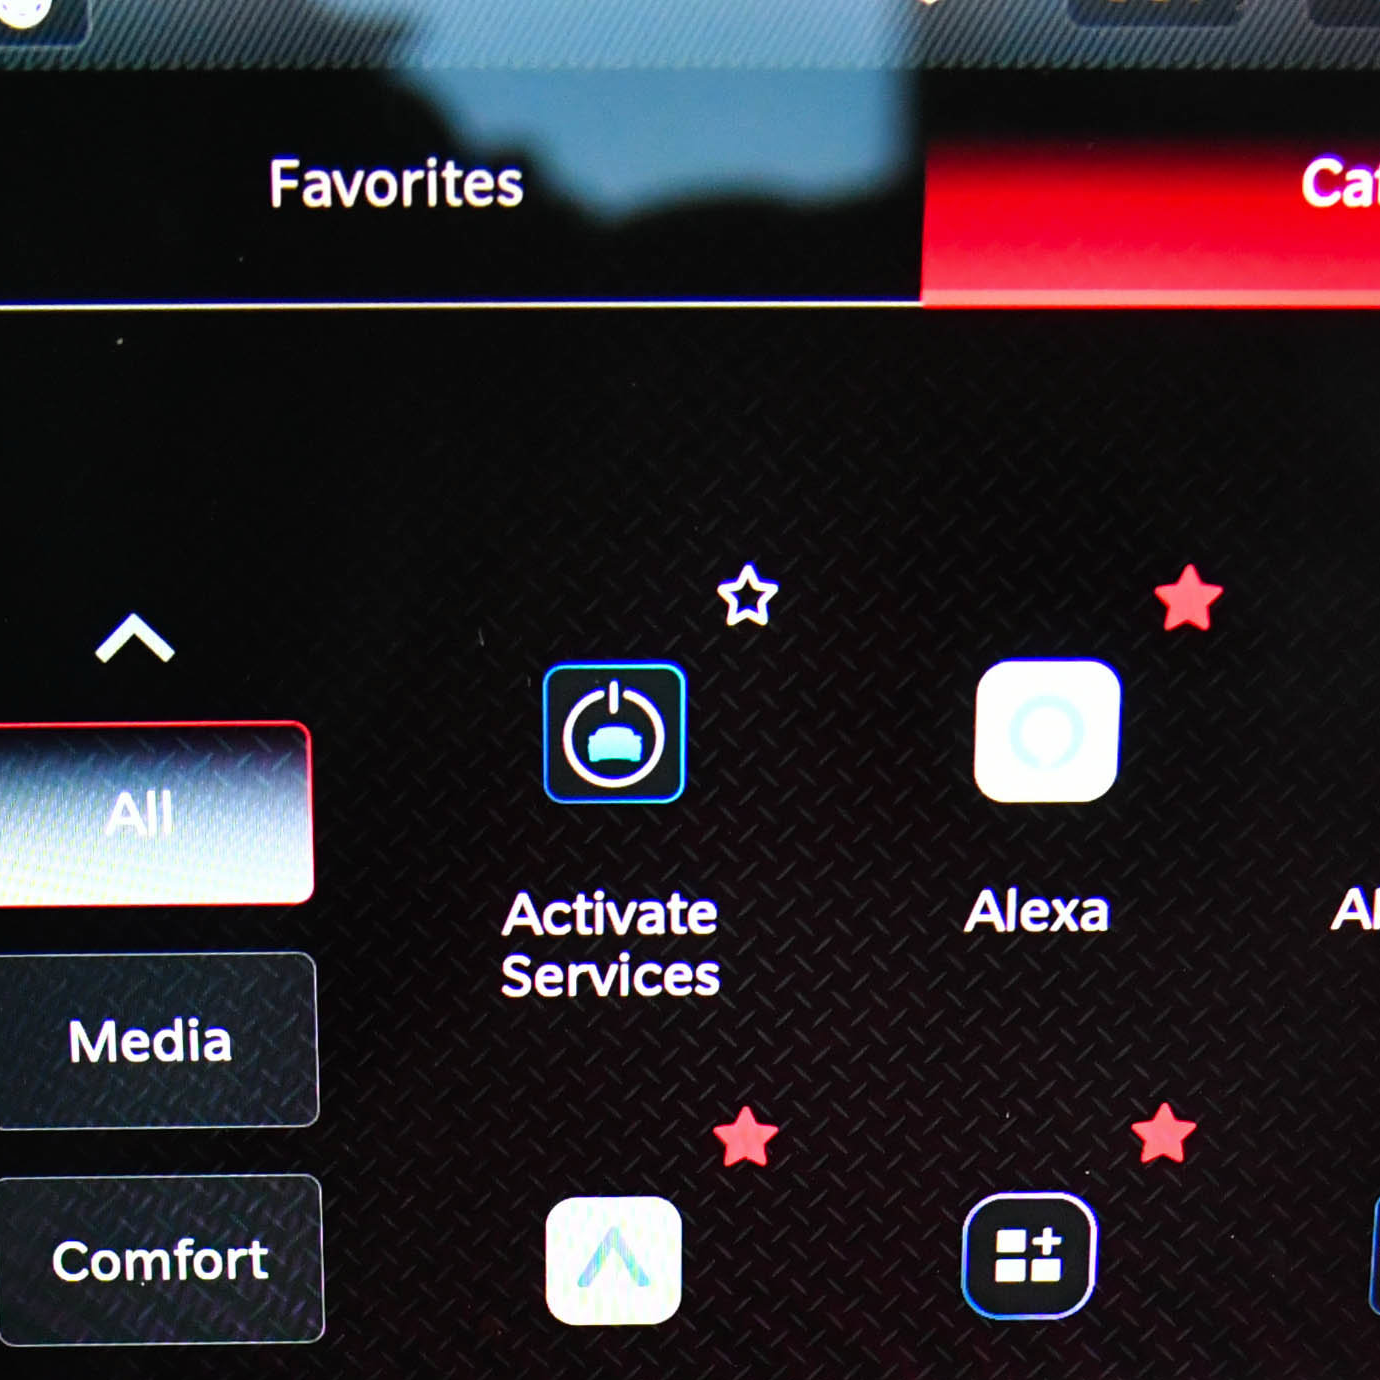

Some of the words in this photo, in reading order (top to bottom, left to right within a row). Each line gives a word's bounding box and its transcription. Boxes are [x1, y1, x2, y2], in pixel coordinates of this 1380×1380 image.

[270, 155, 525, 209] Favorites
[104, 789, 174, 838] All
[500, 889, 719, 938] Activate
[962, 886, 1110, 934] Alexa
[500, 950, 721, 999] Services
[68, 1016, 234, 1064] Media
[51, 1236, 270, 1283] Comfort
